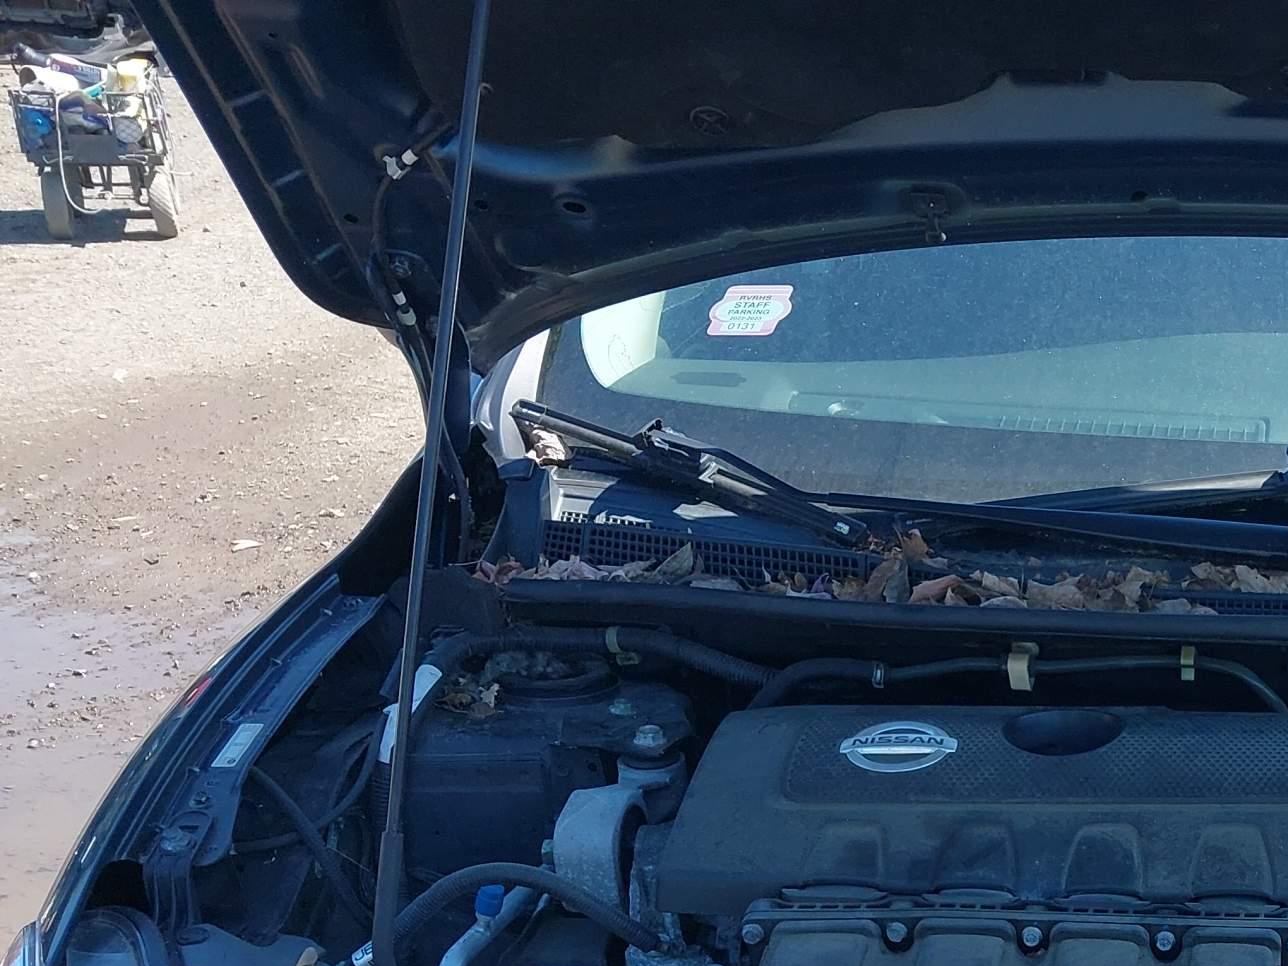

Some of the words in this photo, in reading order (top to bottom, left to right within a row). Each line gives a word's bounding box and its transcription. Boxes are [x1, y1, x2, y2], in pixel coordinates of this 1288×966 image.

[734, 301, 772, 309] STAFF
[727, 322, 756, 330] 0131
[851, 735, 945, 746] NISSAN
